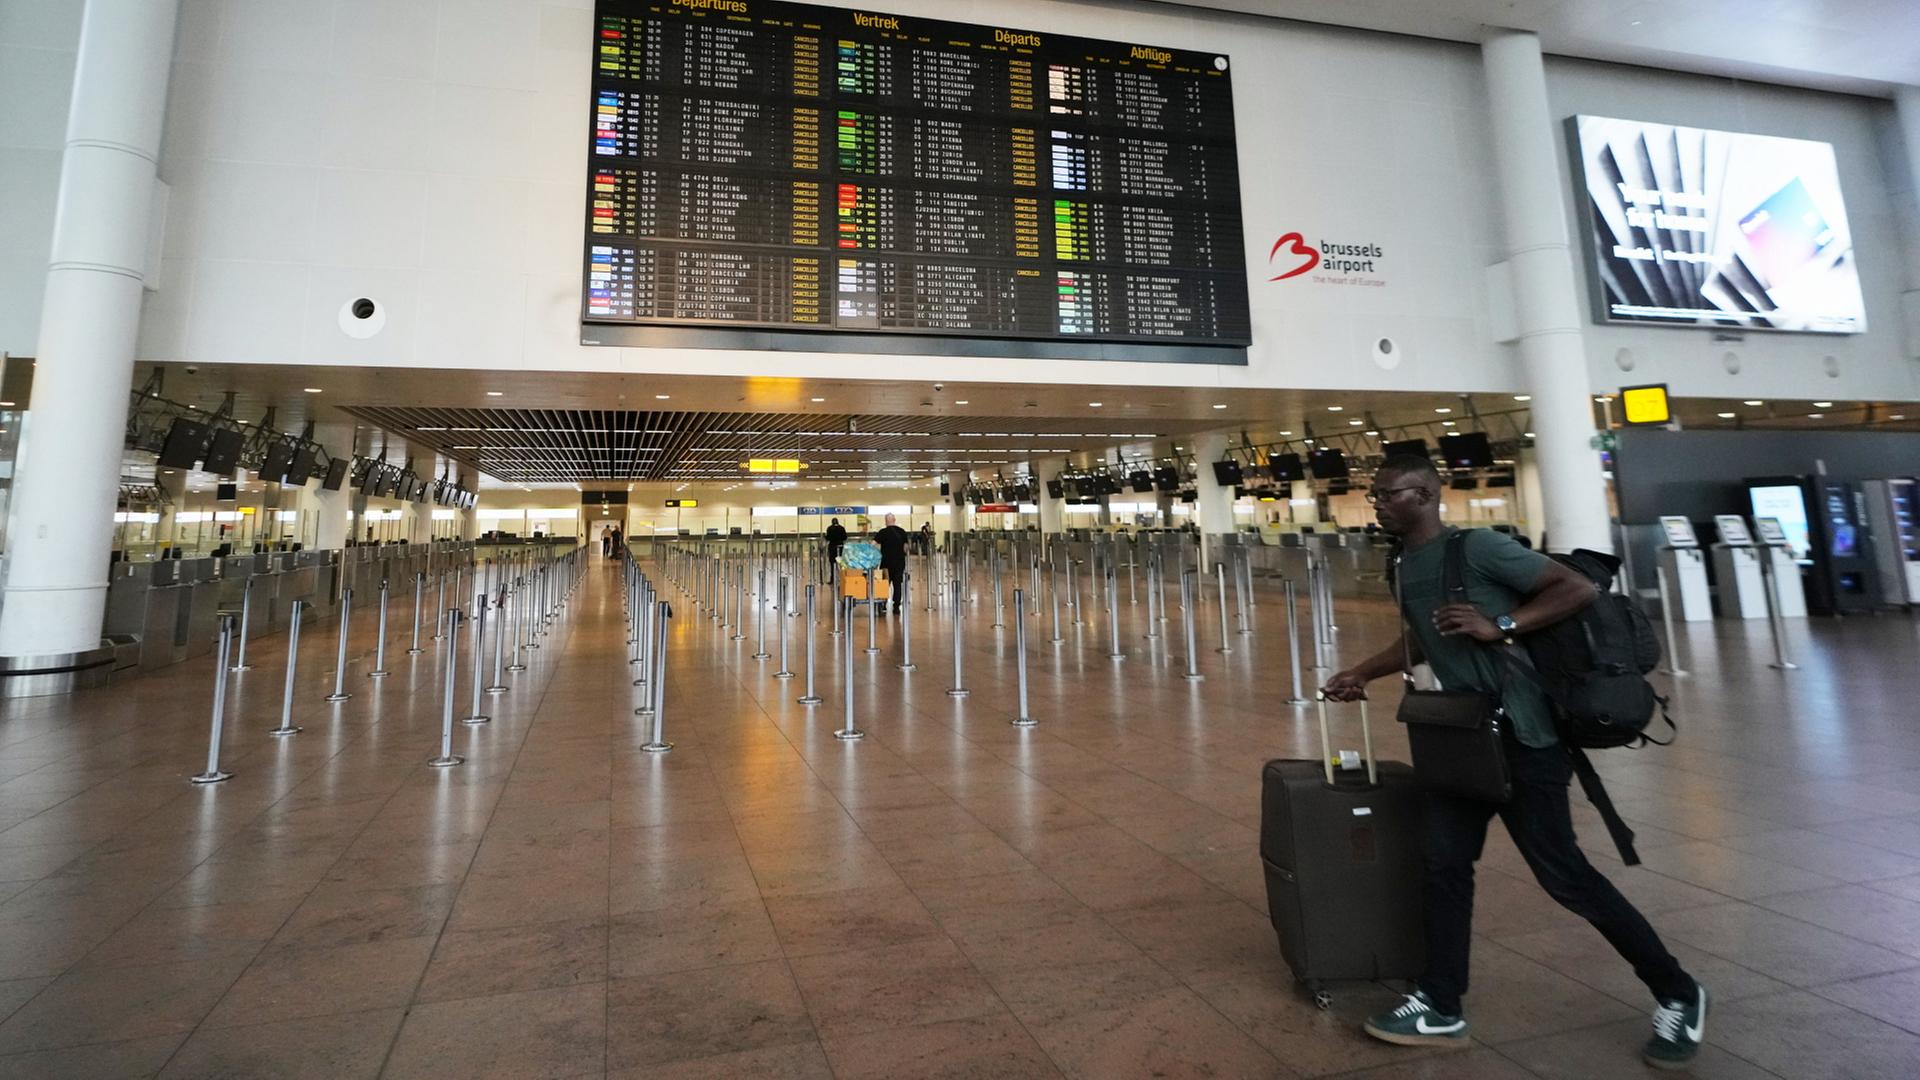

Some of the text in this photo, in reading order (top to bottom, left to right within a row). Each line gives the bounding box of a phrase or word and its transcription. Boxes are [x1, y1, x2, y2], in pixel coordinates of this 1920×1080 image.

[854, 12, 899, 30] Vertrek
[995, 29, 1040, 46] Départs
[1130, 46, 1171, 64] Abflüge
[715, 101, 759, 110] THESSALONIKI
[1321, 240, 1382, 257] brussels
[1323, 256, 1374, 274] airport
[1349, 276, 1357, 285] of
[1359, 278, 1386, 287] Europe
